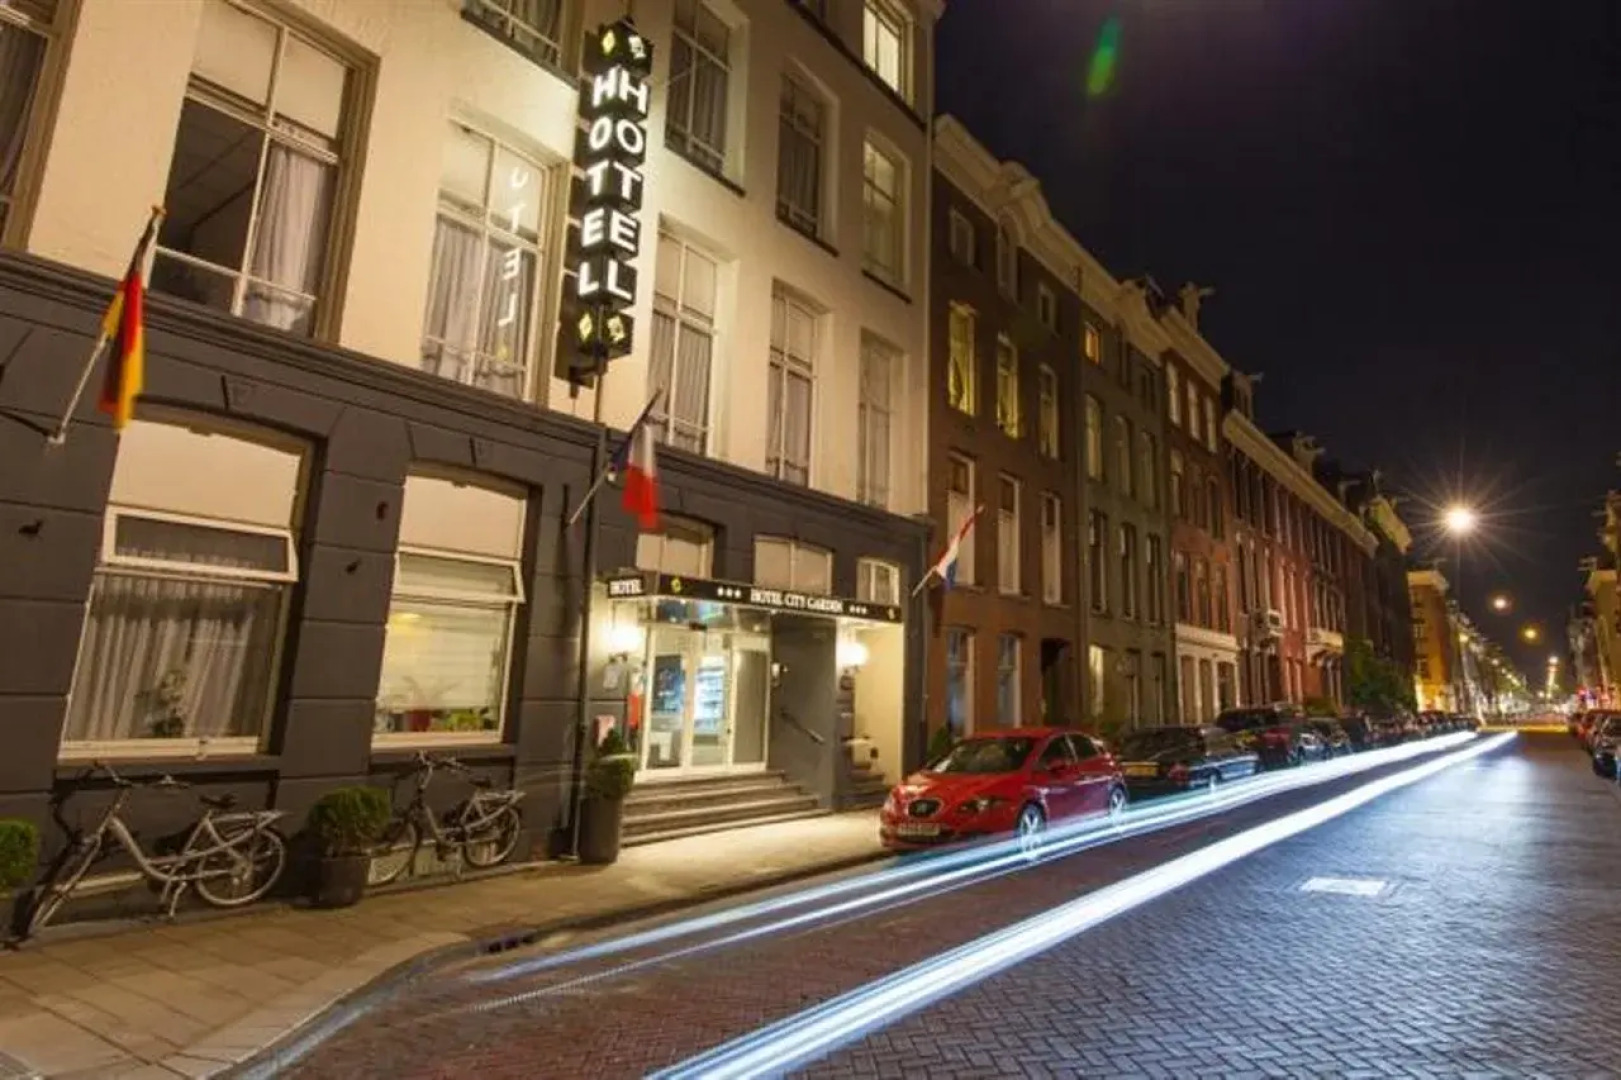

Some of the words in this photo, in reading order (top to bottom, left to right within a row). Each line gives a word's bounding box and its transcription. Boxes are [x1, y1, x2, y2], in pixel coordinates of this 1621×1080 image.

[577, 65, 618, 296] HOTEL
[607, 70, 648, 301] HOTEL
[610, 579, 642, 595] HOTEL
[750, 588, 783, 606] HOTEL
[784, 593, 806, 609] CITY
